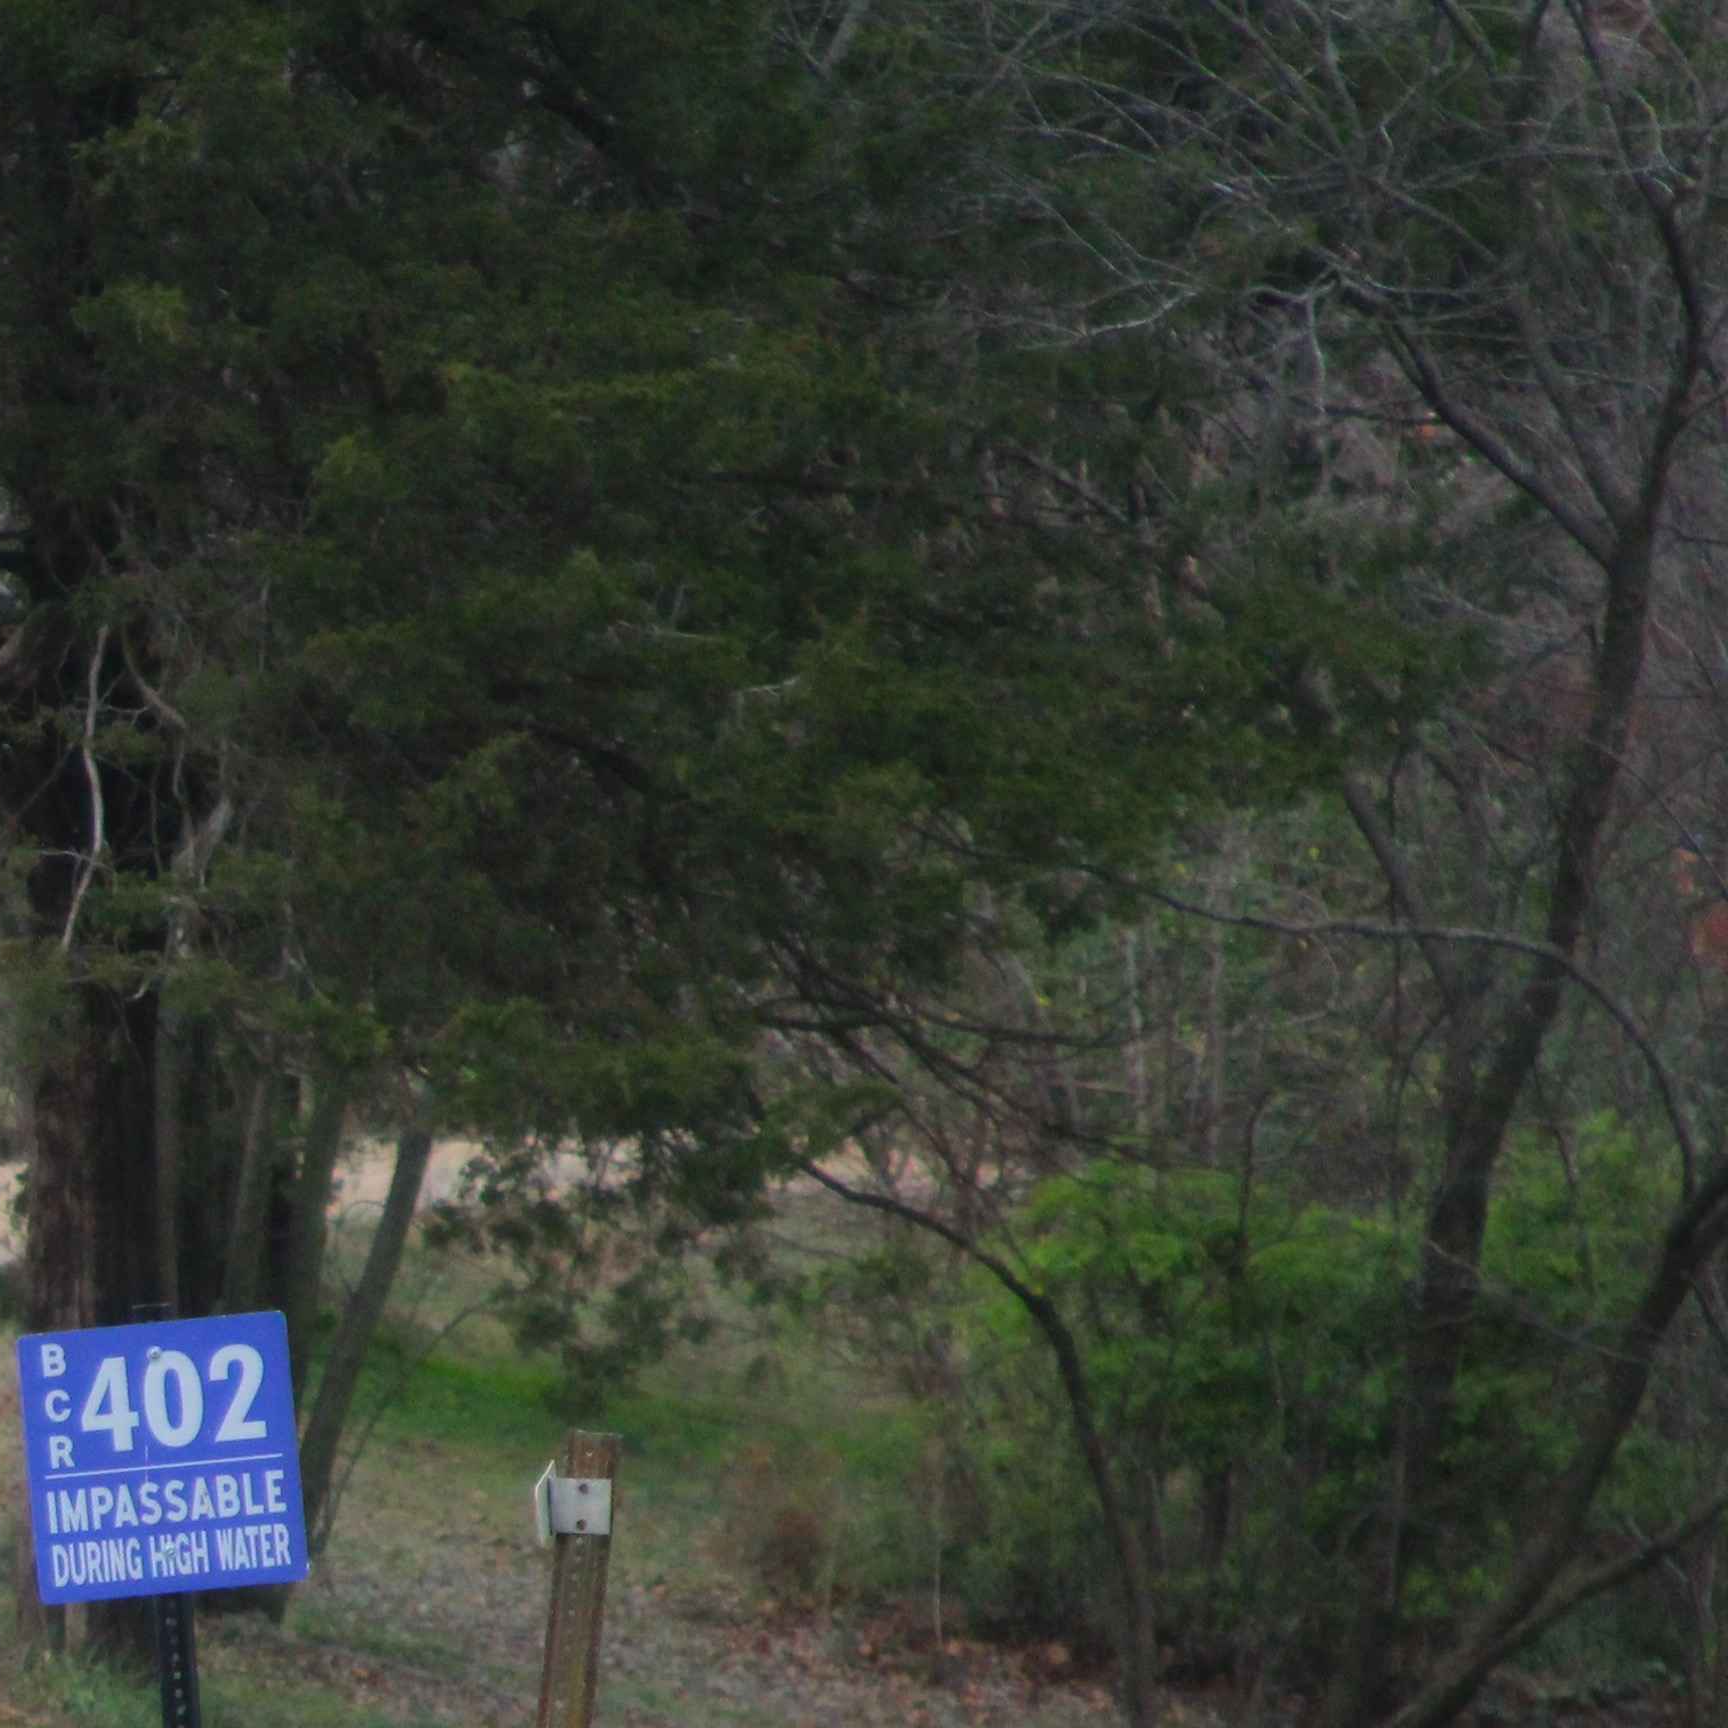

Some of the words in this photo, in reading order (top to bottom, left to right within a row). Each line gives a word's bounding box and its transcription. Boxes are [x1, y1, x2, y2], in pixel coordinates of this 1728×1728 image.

[81, 1344, 267, 1451] 402
[46, 1470, 288, 1534] IMPASSABLE
[52, 1538, 144, 1588] DURING
[149, 1530, 211, 1578] HIGH
[216, 1523, 292, 1571] WATER
